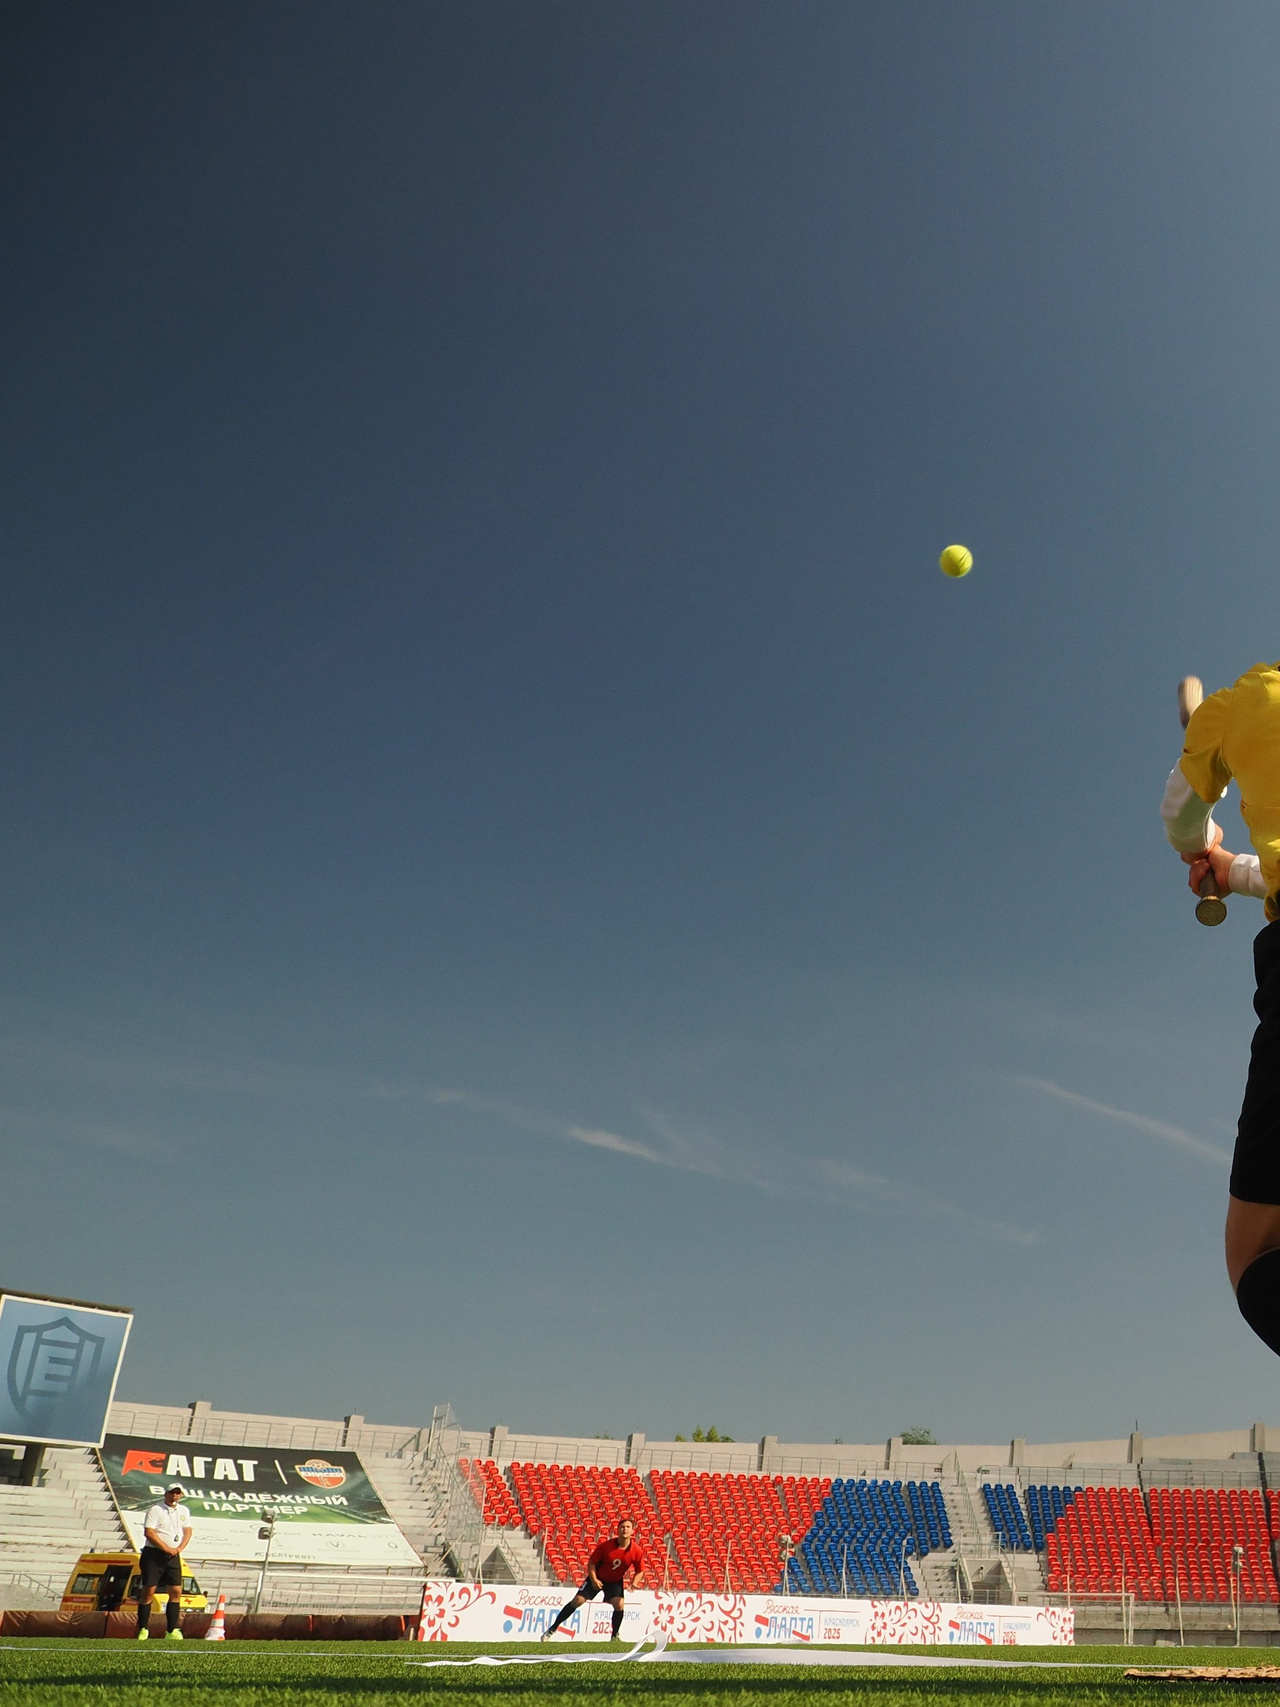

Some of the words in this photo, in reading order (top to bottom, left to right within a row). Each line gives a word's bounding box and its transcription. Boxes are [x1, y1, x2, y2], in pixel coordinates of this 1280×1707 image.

[166, 1454, 258, 1482] АГАТ
[149, 1485, 205, 1499] ВШ
[209, 1490, 349, 1506] НАДЕЖНЫЙ
[203, 1501, 308, 1515] ПАРТНЕР
[612, 1558, 622, 1570] 9
[515, 1588, 564, 1607] Русская
[763, 1599, 800, 1615] Русская
[518, 1607, 581, 1634] ЛАПА
[594, 1610, 641, 1621] КРАСЯРСК
[824, 1617, 859, 1627] КРАСНОЯРСК
[766, 1616, 814, 1639] ЛАПТА
[823, 1628, 841, 1639] 2025
